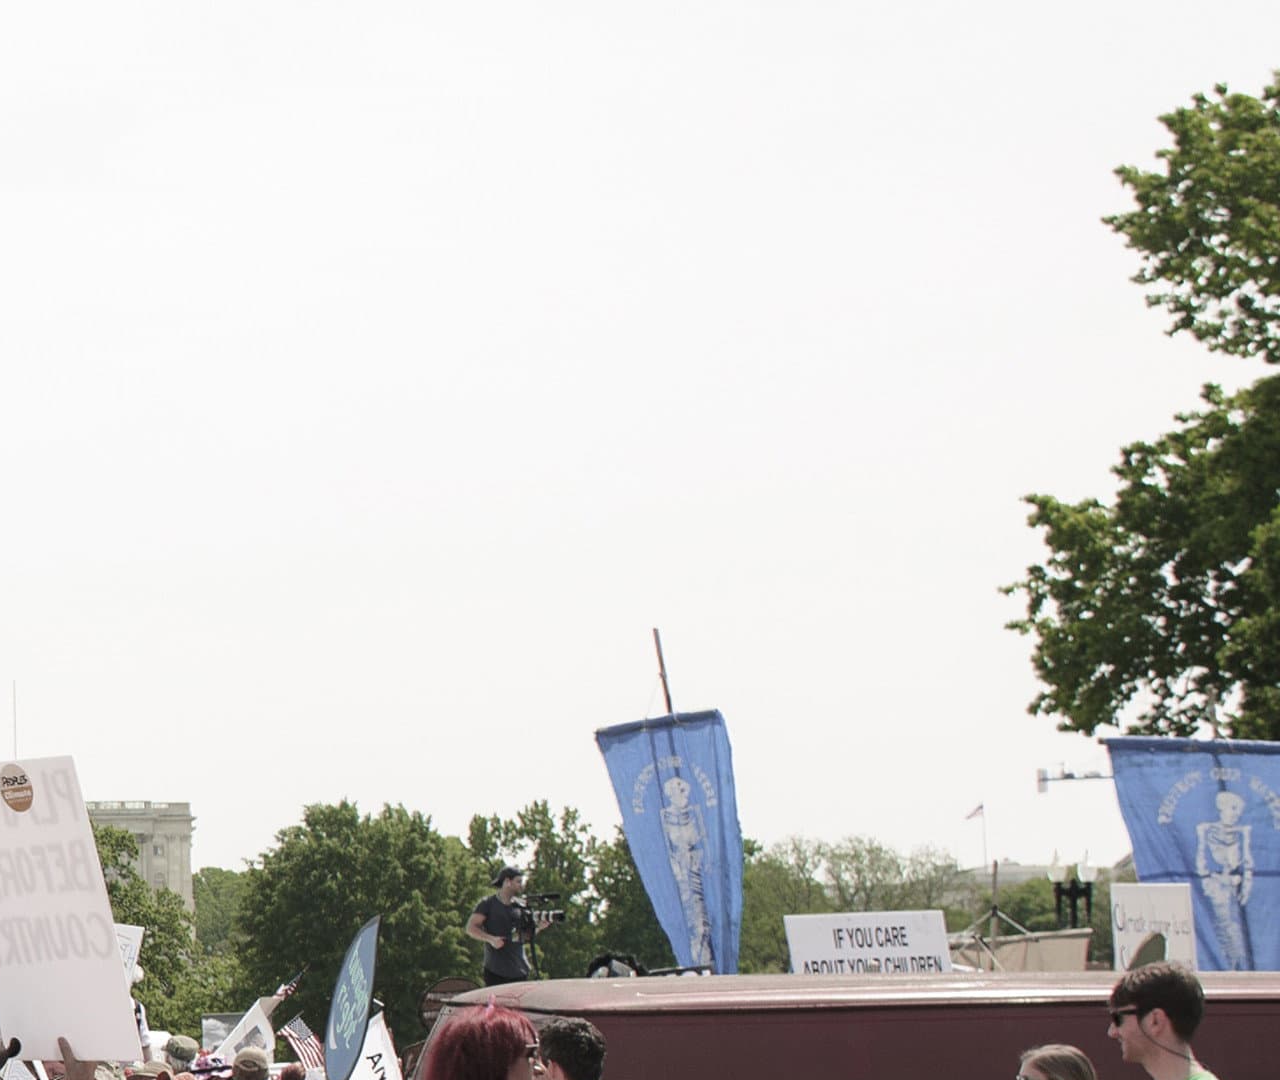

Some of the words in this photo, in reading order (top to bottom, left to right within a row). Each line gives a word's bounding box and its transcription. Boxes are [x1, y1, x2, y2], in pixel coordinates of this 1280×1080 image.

[833, 928, 844, 949] IF
[846, 927, 873, 948] YOU
[875, 926, 909, 947] CARE
